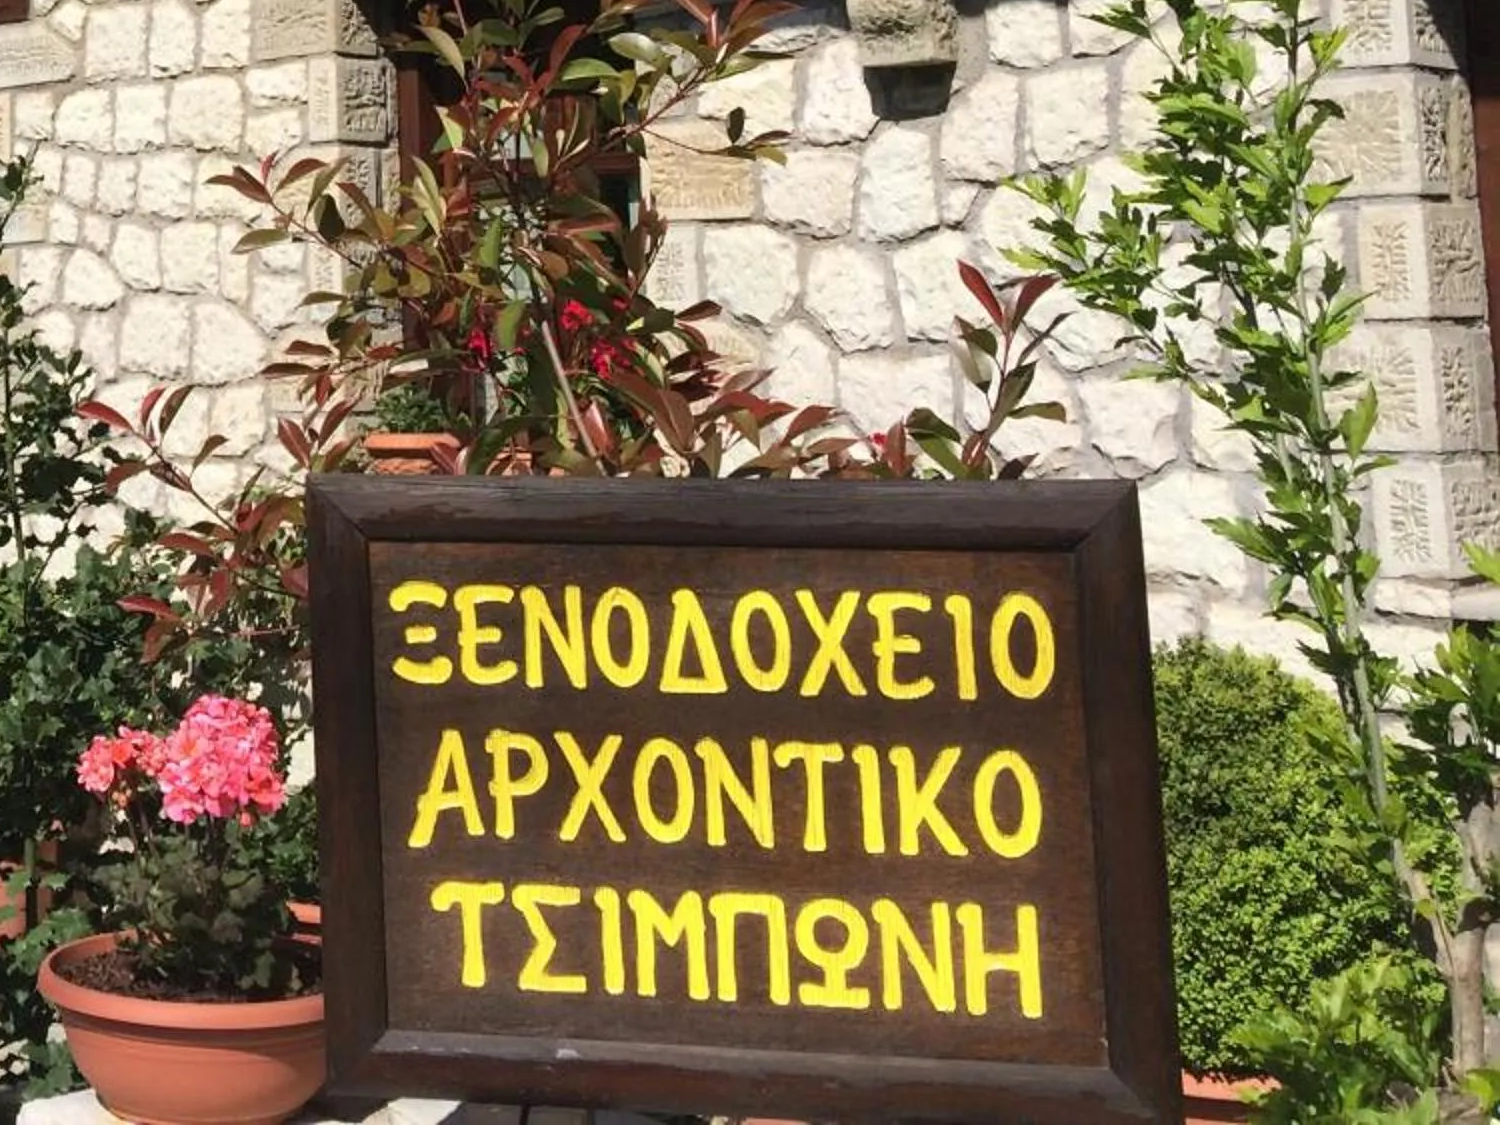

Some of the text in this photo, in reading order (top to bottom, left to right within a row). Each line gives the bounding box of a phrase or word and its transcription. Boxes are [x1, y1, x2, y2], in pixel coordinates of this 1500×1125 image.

[388, 581, 1056, 701] ΞΕΝΟΔΟΧΕΙΟ
[408, 727, 1044, 860] ΑΡΧΟΝΤΙΚΟ
[430, 879, 1044, 1020] ΤΣΙΜΠΩΝΗ
